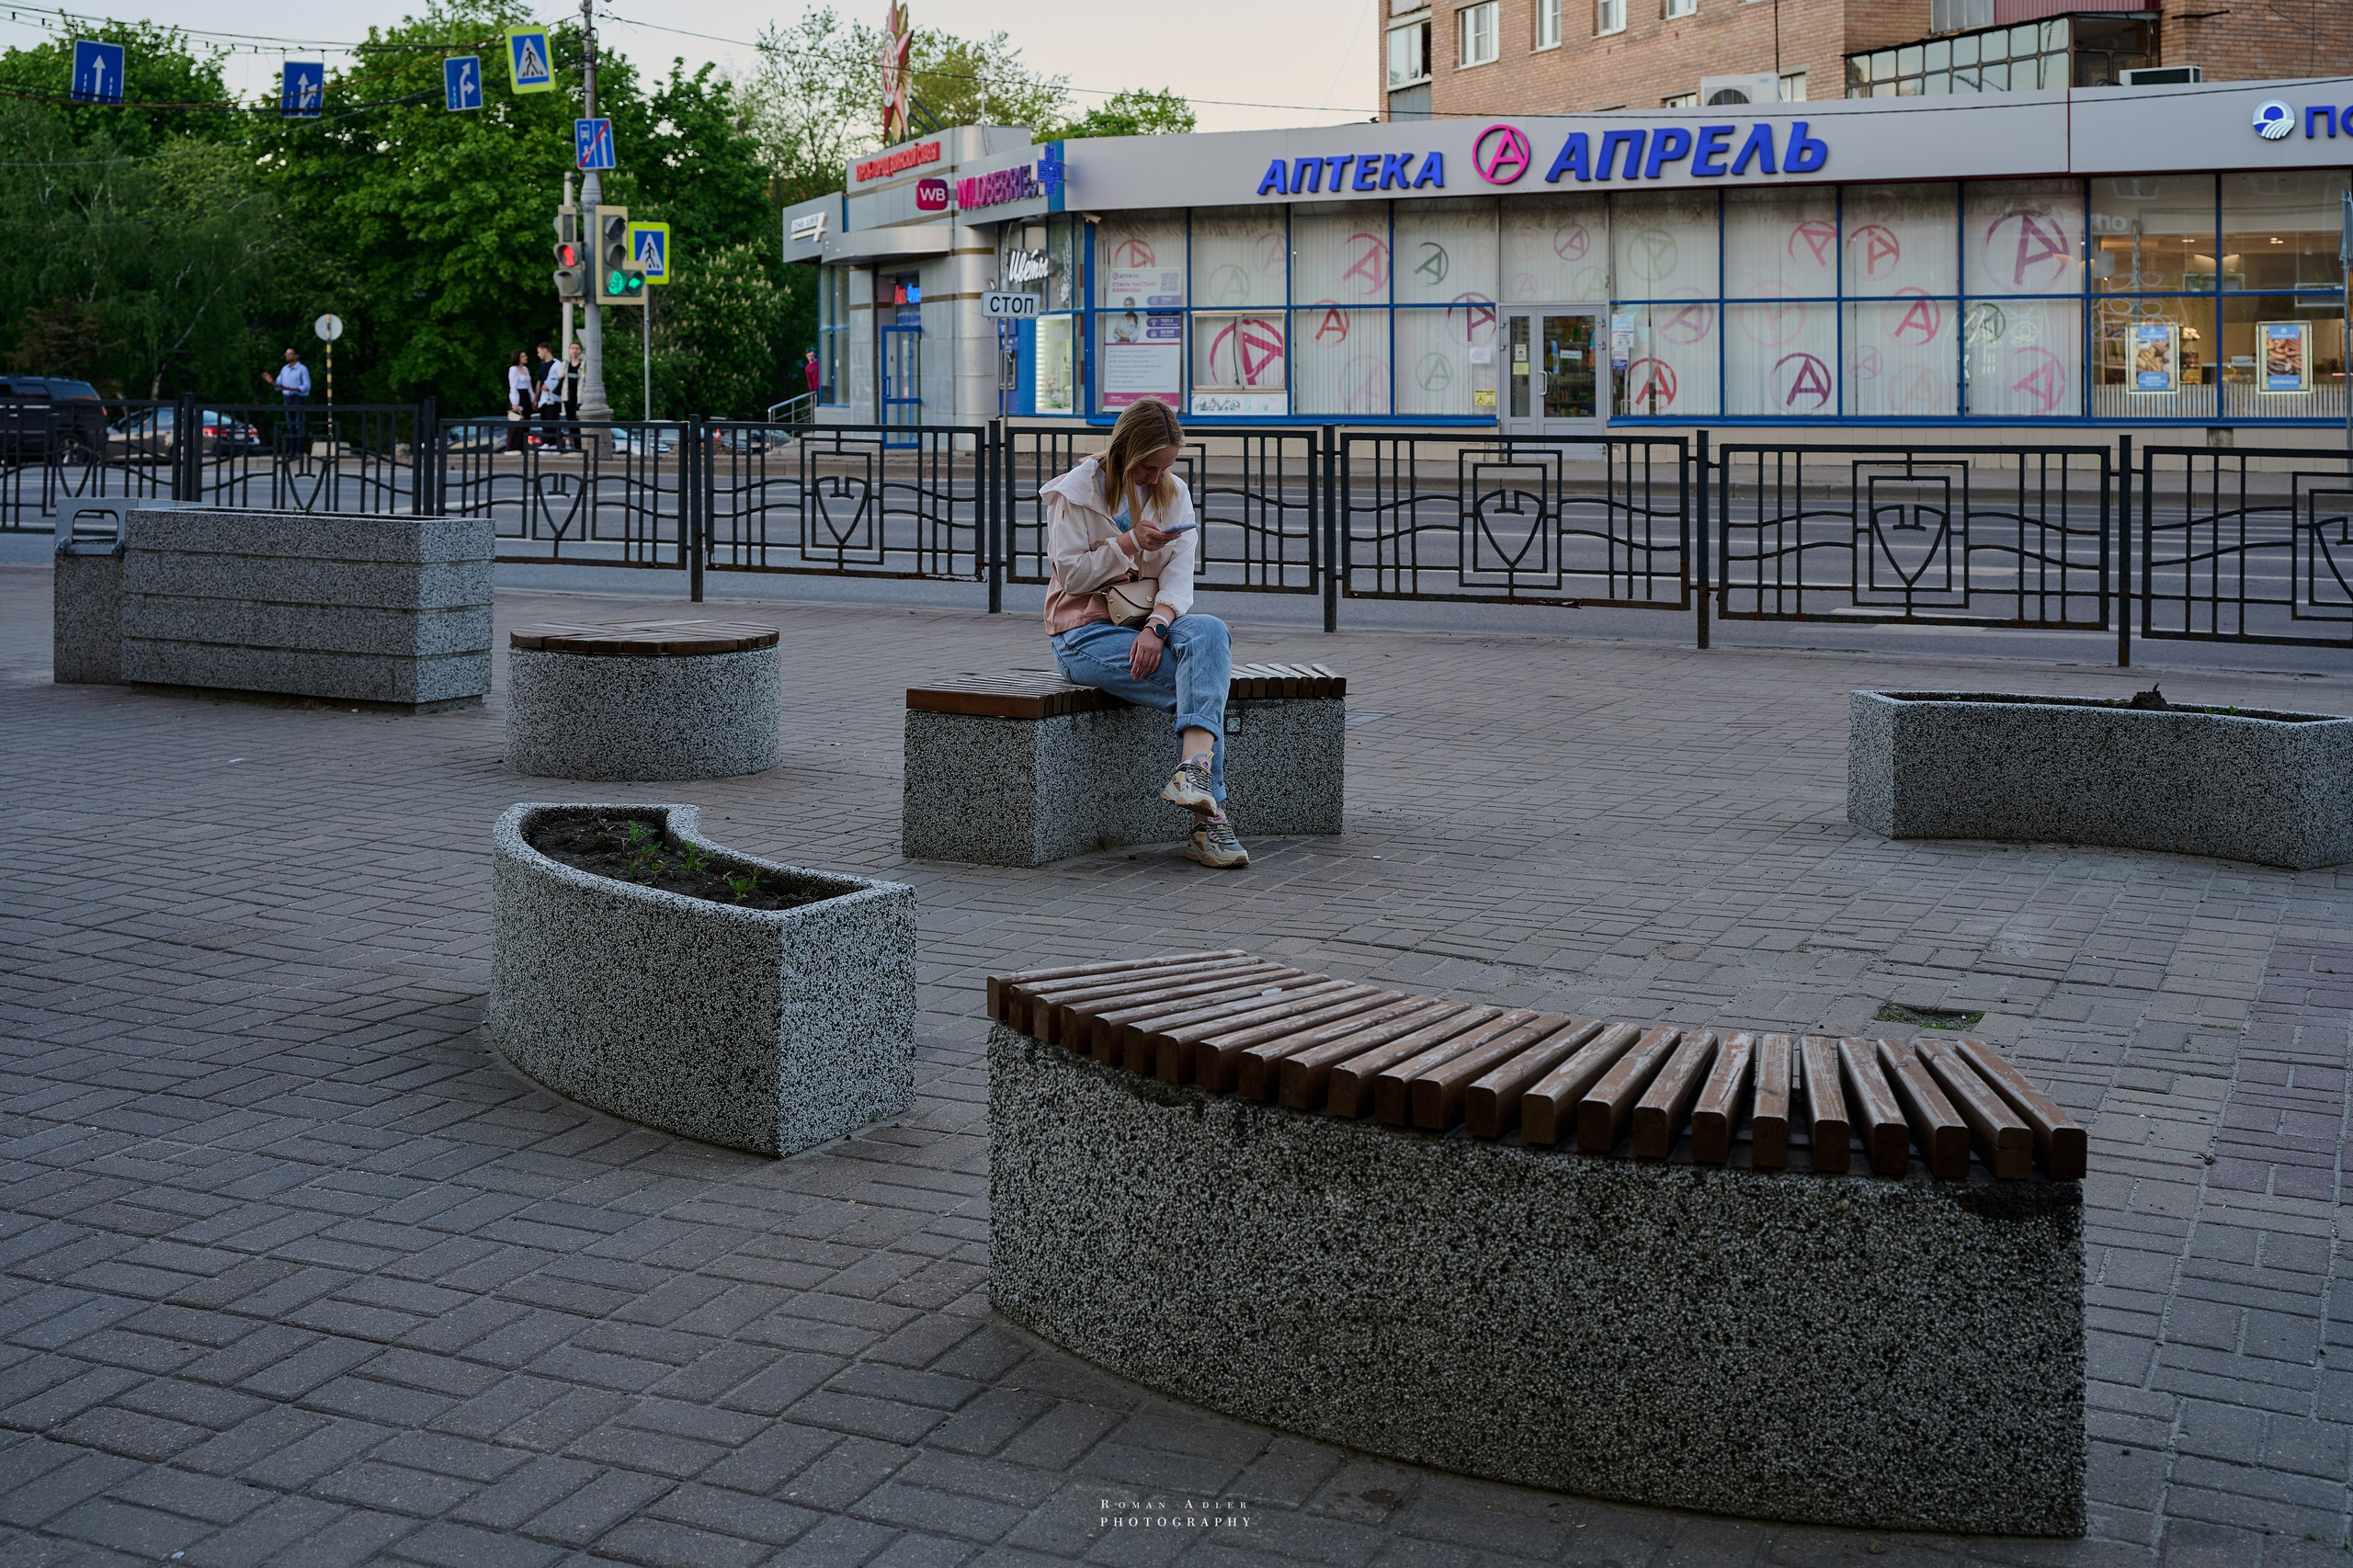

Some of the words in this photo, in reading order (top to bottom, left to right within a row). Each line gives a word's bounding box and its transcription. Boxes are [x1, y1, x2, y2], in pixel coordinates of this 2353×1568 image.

[1256, 150, 1446, 196] АПТЕКА
[1544, 120, 1829, 183] АПРЕЛЬ
[919, 187, 947, 202] WB
[1008, 248, 1049, 283] Цветы
[990, 296, 1034, 314] СТОП
